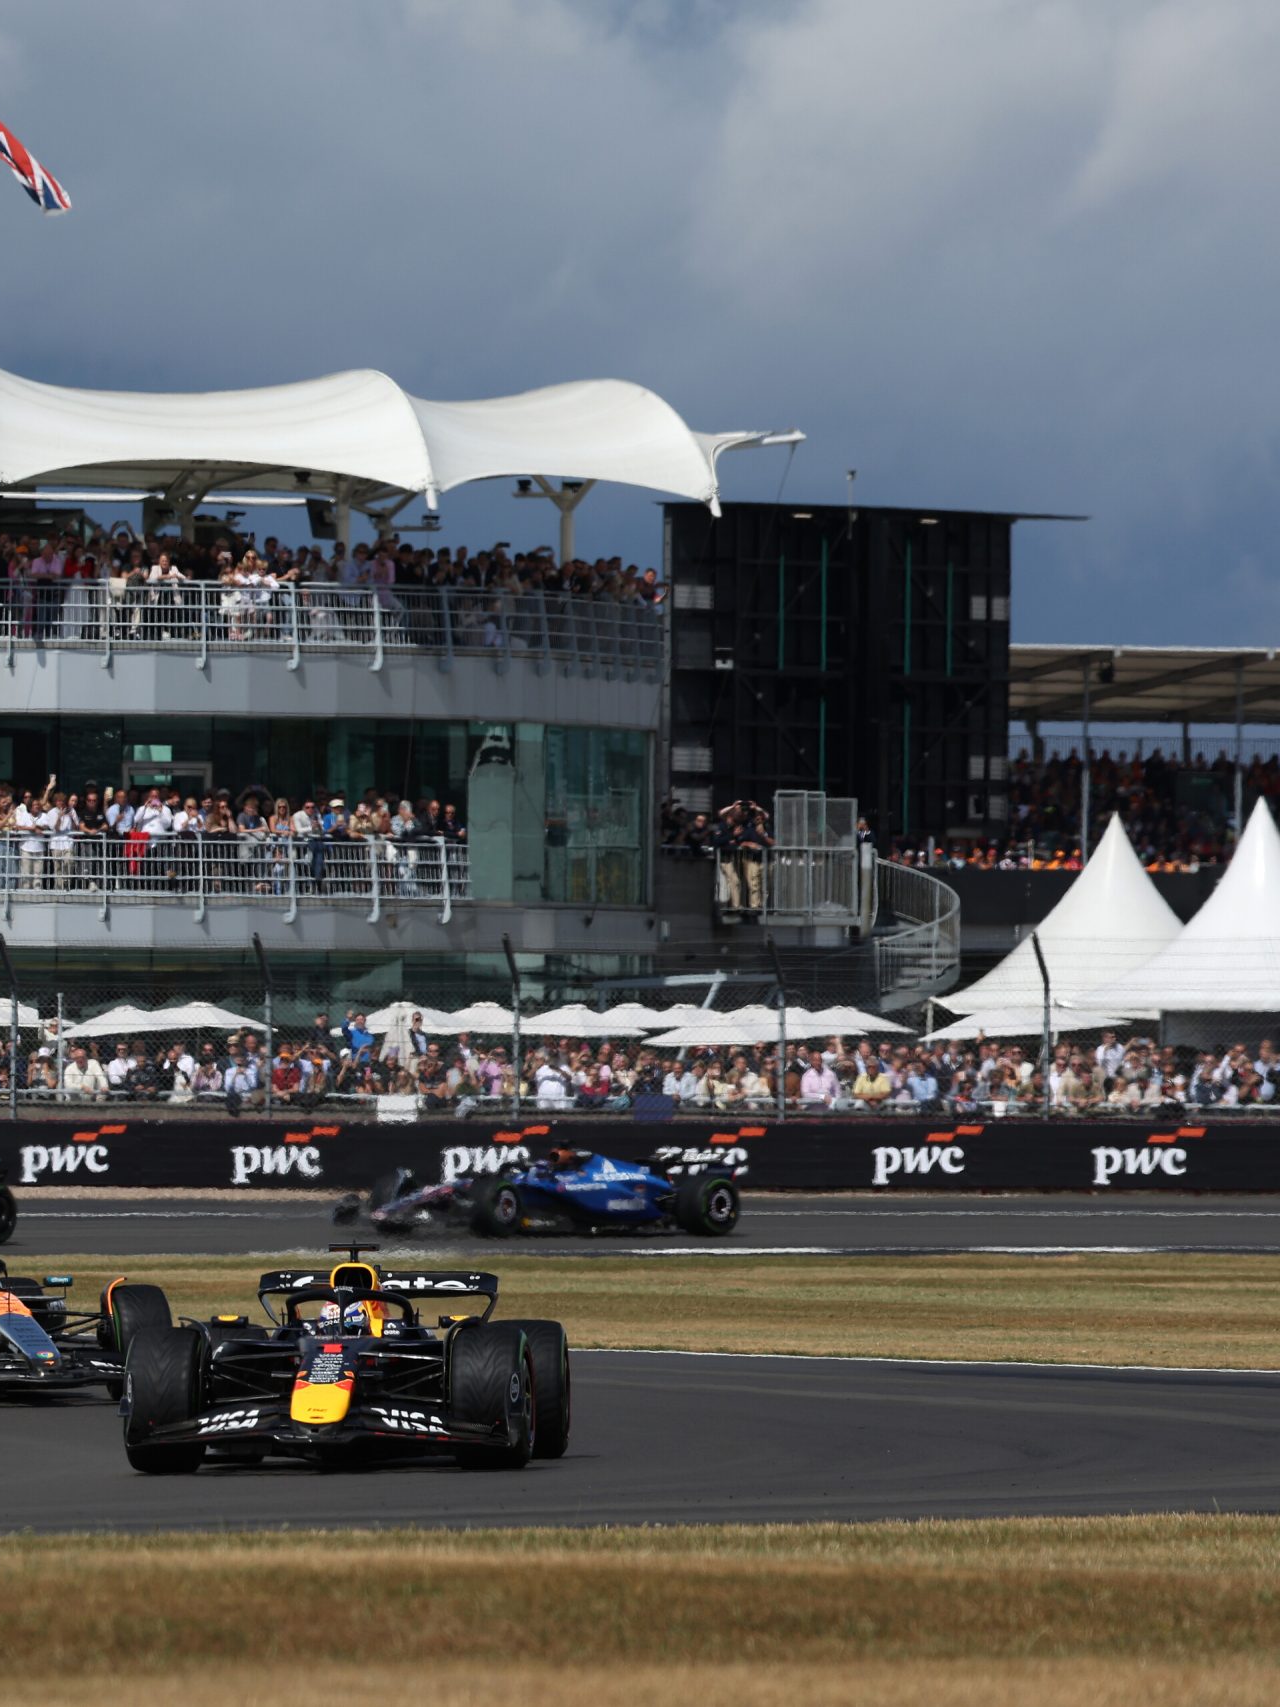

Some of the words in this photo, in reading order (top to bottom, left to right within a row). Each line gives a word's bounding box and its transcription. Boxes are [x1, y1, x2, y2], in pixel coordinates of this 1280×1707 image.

[21, 1145, 108, 1184] pwc
[231, 1146, 322, 1184] pwc
[872, 1146, 964, 1187] pwc
[1092, 1147, 1186, 1187] pwc
